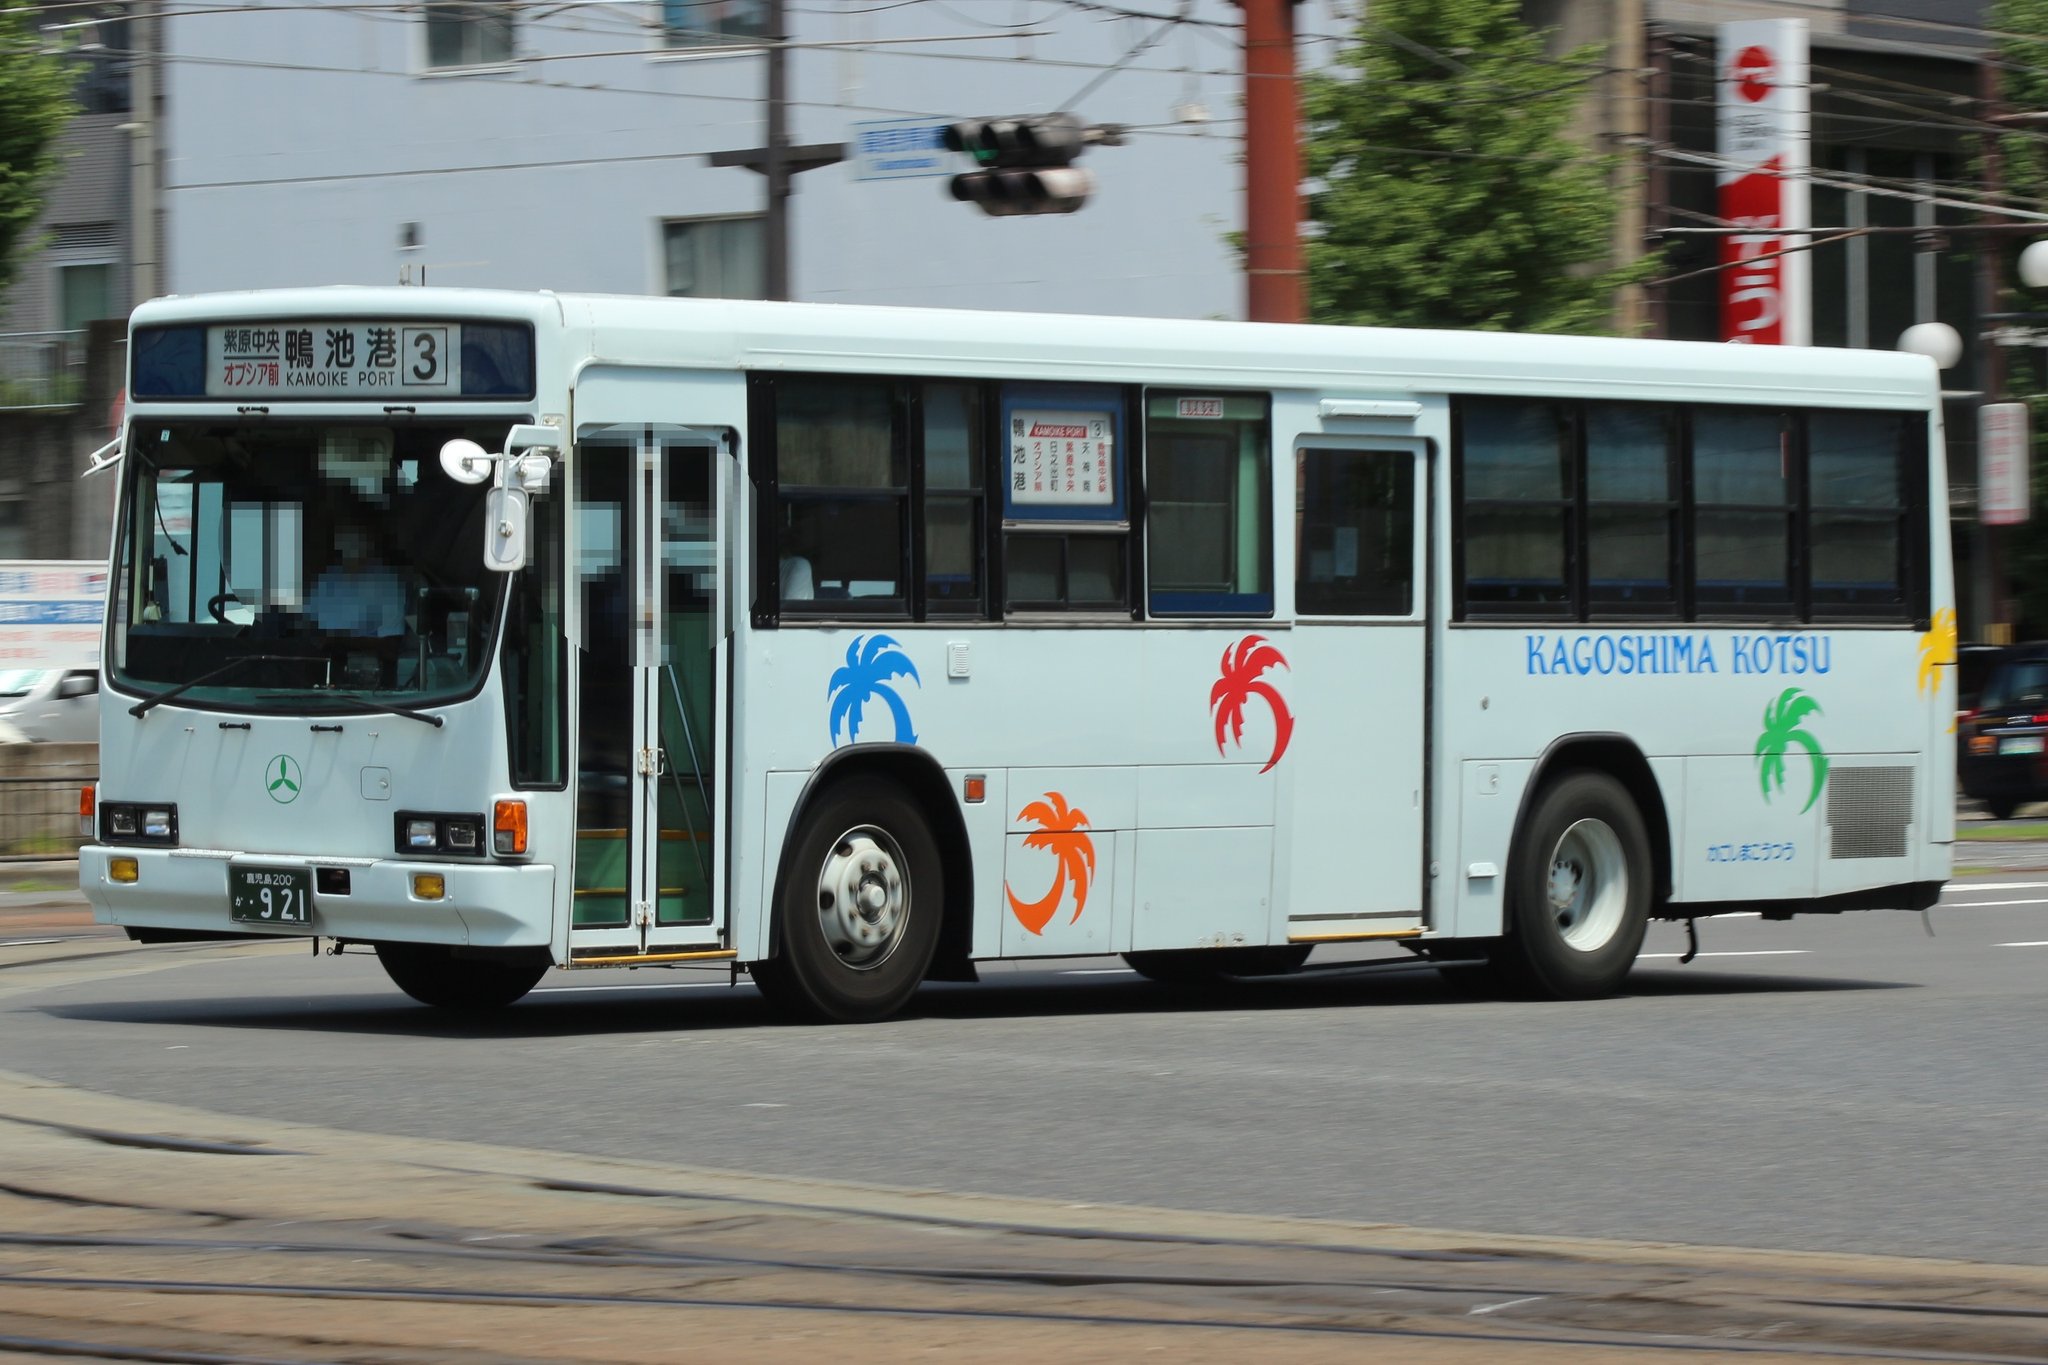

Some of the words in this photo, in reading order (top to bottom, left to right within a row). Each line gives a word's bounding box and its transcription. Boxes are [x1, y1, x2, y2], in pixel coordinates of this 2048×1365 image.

[223, 328, 280, 354] 紫原中央
[285, 328, 397, 369] 鴨池港
[412, 332, 438, 380] 3
[223, 363, 280, 387] オプシア前
[286, 371, 349, 386] KAMOIKE
[358, 371, 396, 386] PORT
[1525, 634, 1718, 676] KAGOSHIMA
[1731, 634, 1832, 675] KOTSU
